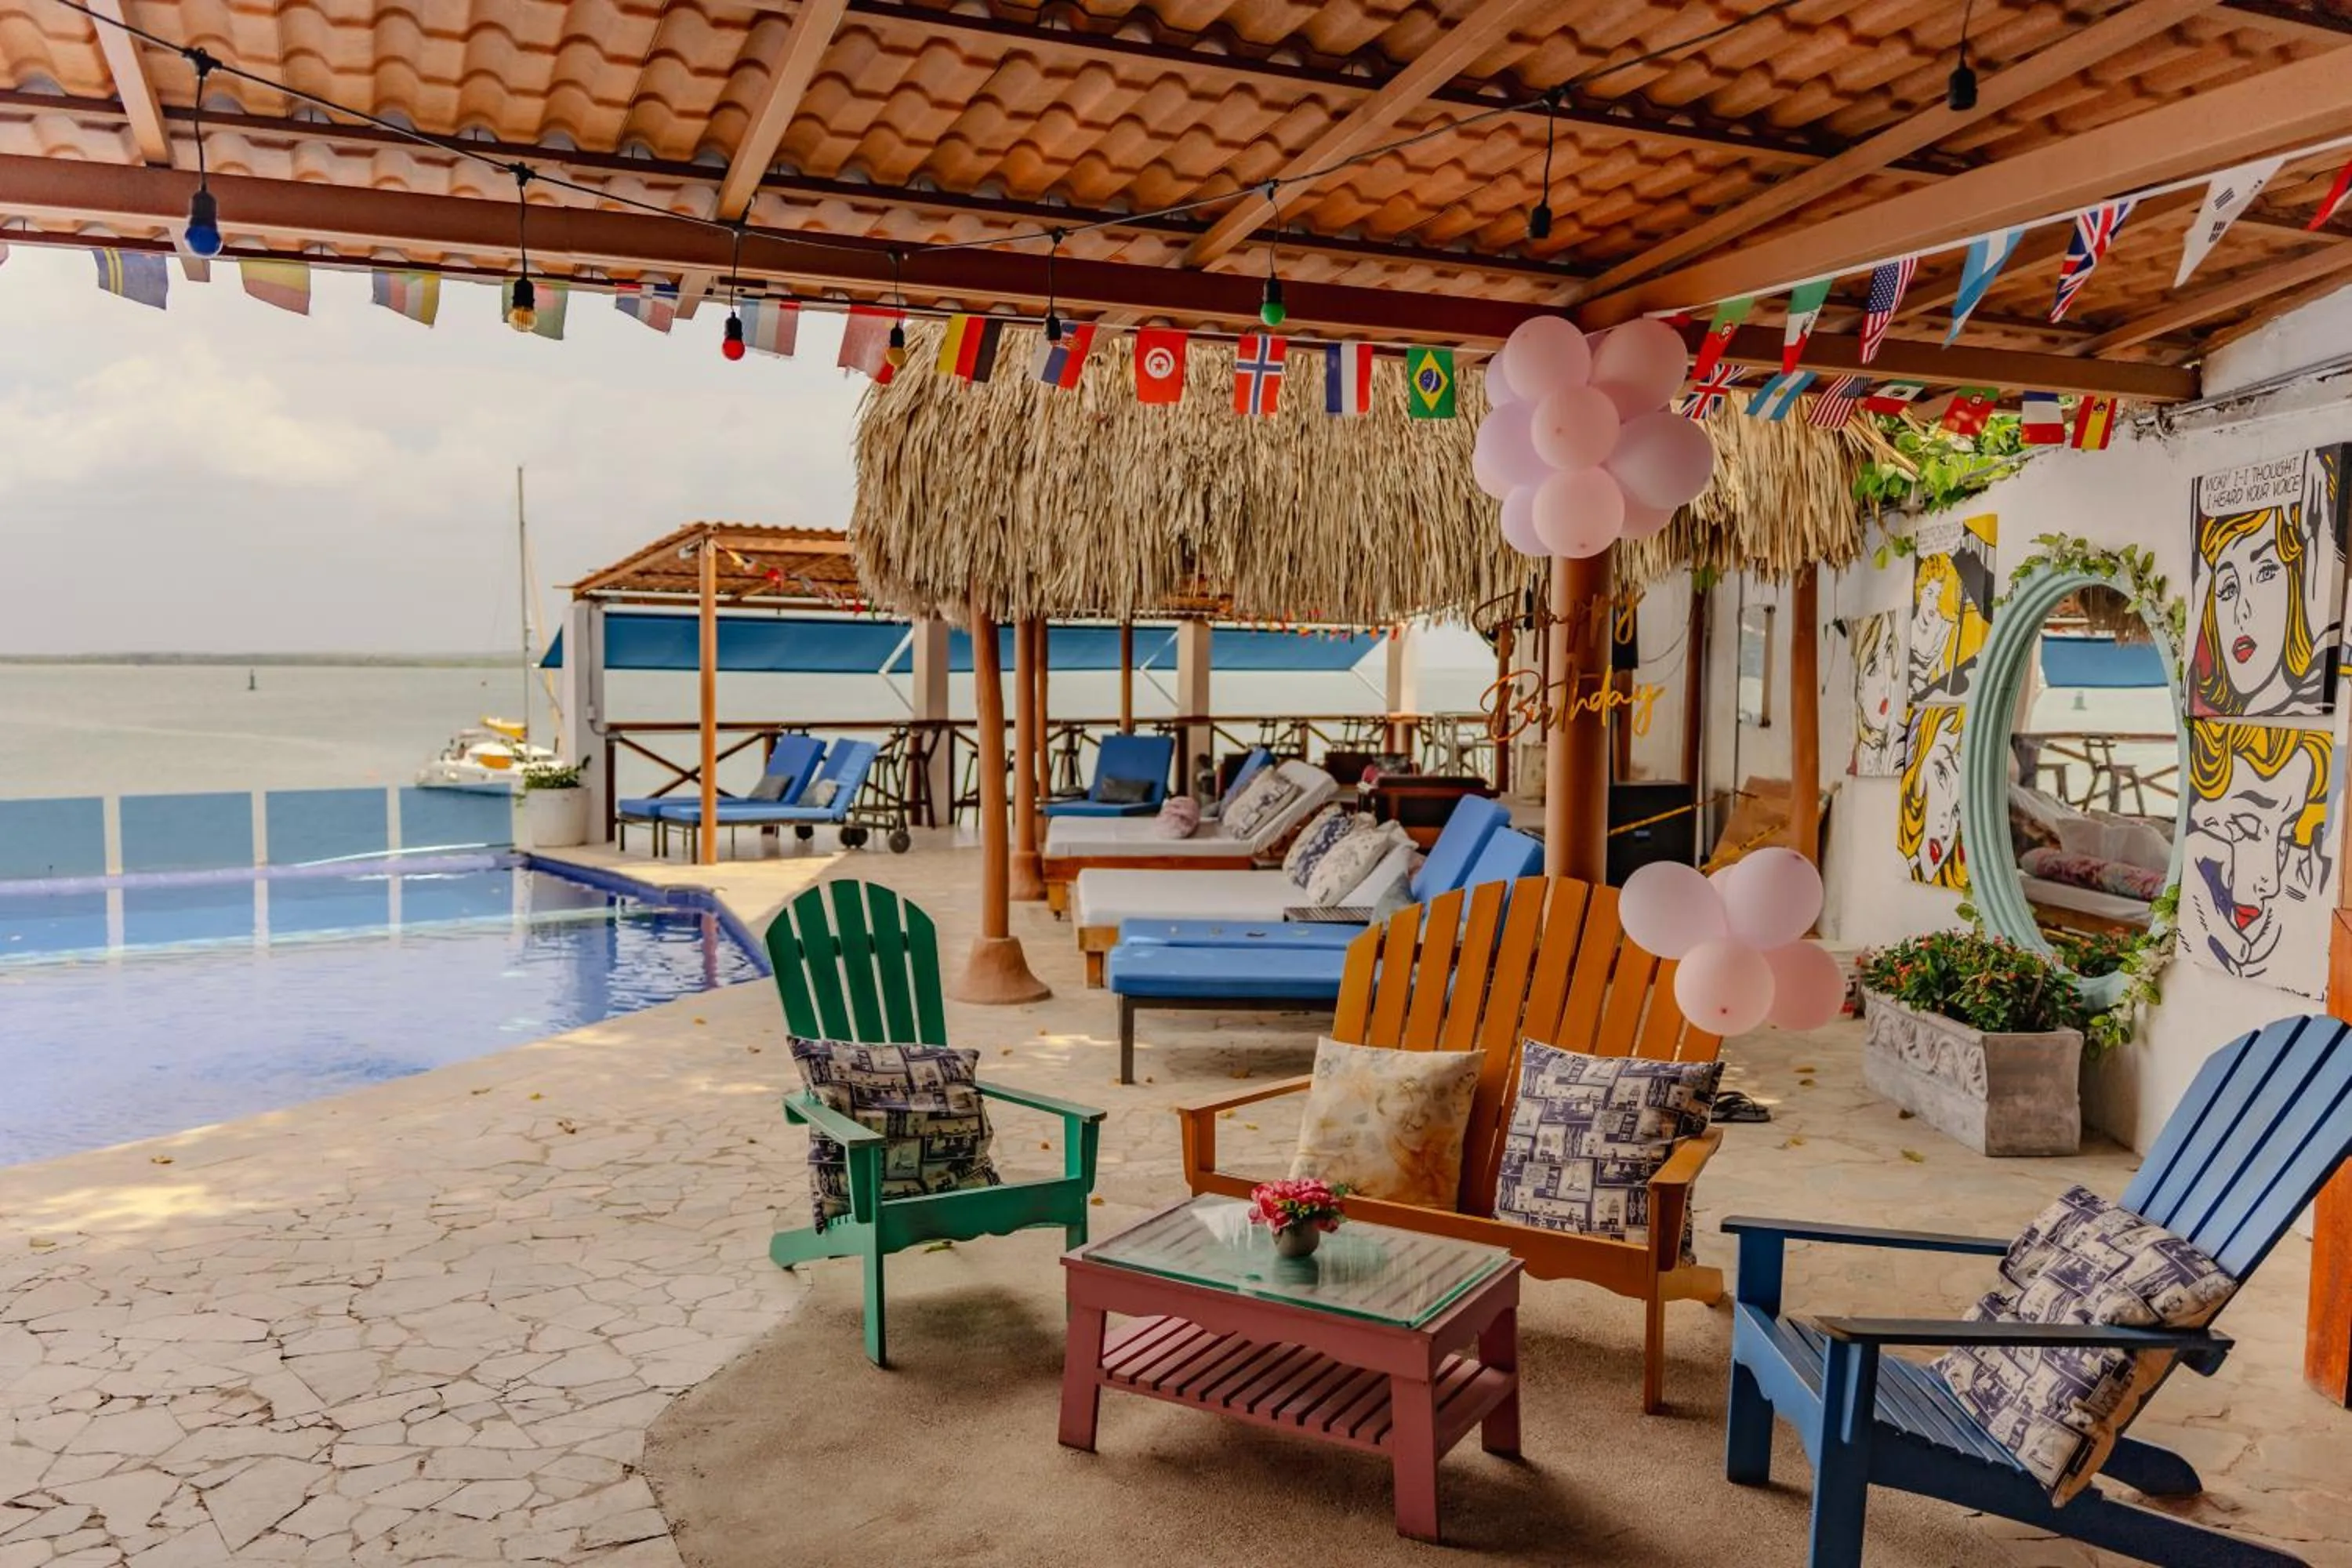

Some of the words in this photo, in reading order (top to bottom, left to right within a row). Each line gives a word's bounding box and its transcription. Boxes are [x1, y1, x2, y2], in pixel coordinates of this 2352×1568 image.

[2252, 457, 2299, 483] THOUGHT
[2212, 488, 2243, 508] HEARD
[2246, 483, 2271, 503] YOUR
[1480, 654, 1666, 742] Birthday
